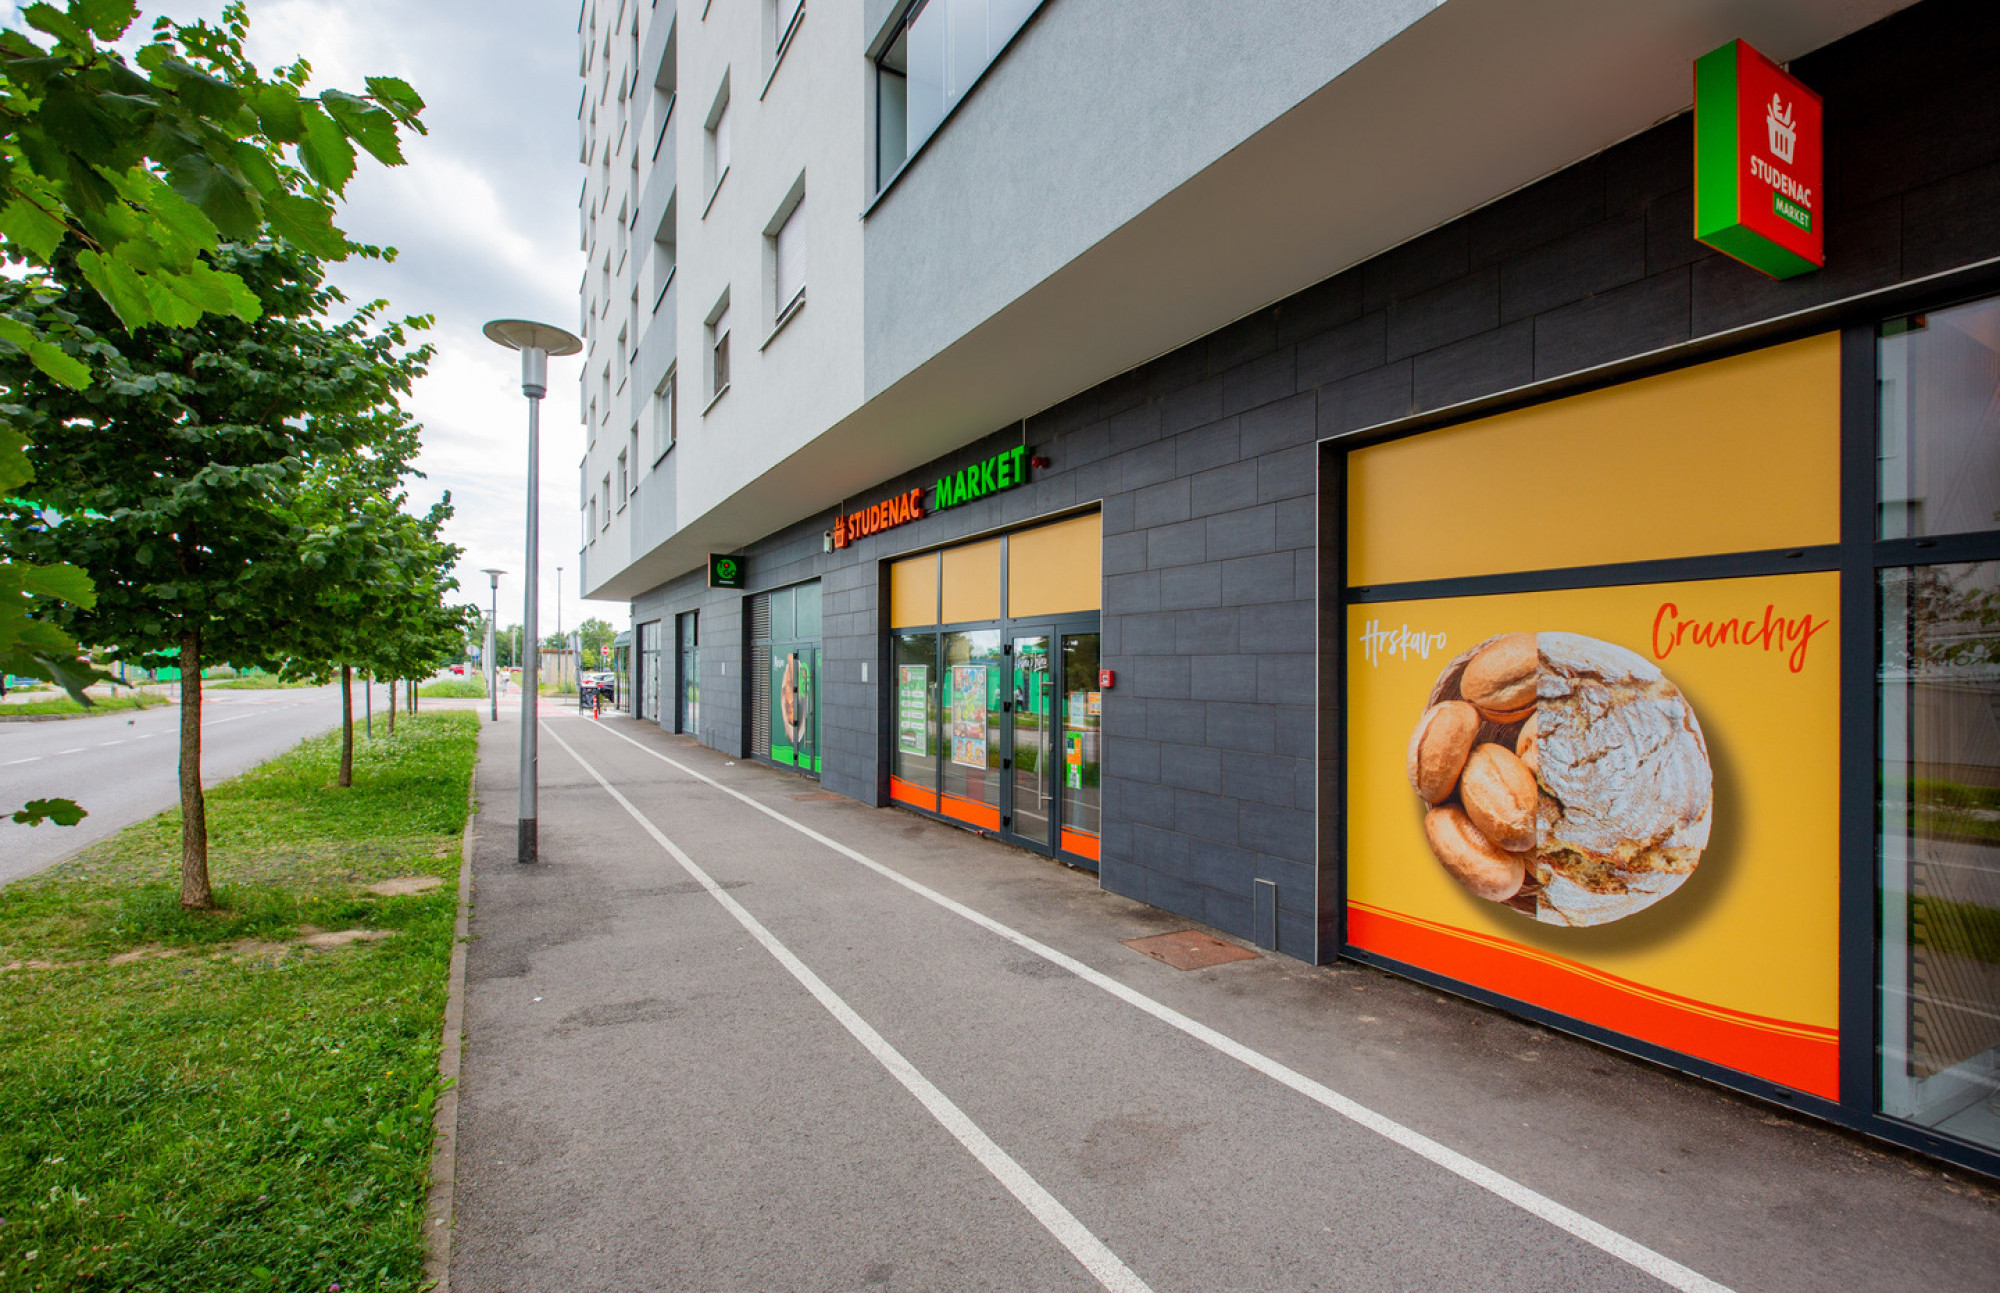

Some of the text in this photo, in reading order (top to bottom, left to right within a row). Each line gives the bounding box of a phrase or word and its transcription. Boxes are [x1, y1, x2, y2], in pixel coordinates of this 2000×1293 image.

[1751, 155, 1812, 208] STUDENAC
[1776, 198, 1809, 228] MARKET
[848, 445, 1028, 540] STUDENAC MARKET
[1360, 619, 1447, 667] Hrskavo
[1652, 602, 1829, 673] Crunchy
